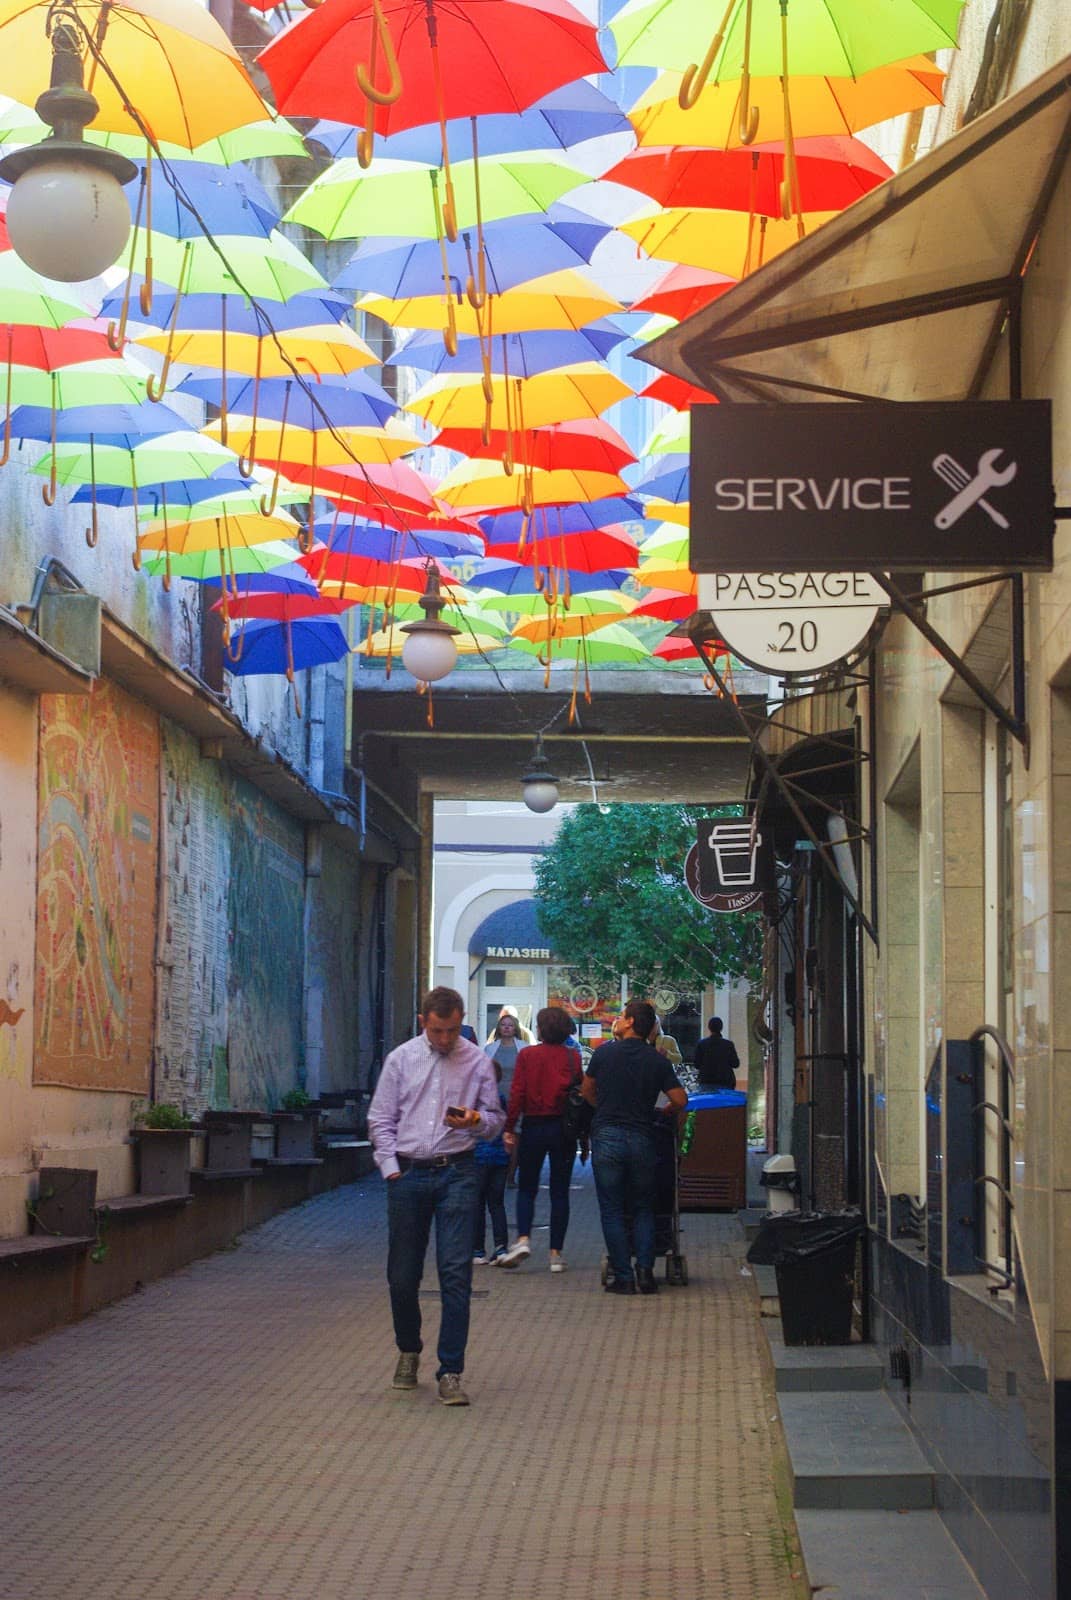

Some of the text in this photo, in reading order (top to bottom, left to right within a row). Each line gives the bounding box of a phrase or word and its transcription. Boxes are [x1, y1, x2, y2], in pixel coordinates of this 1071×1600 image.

[715, 477, 911, 511] SERVICE
[714, 572, 871, 600] PASSAGE
[486, 946, 551, 959] МАГАЗИН
